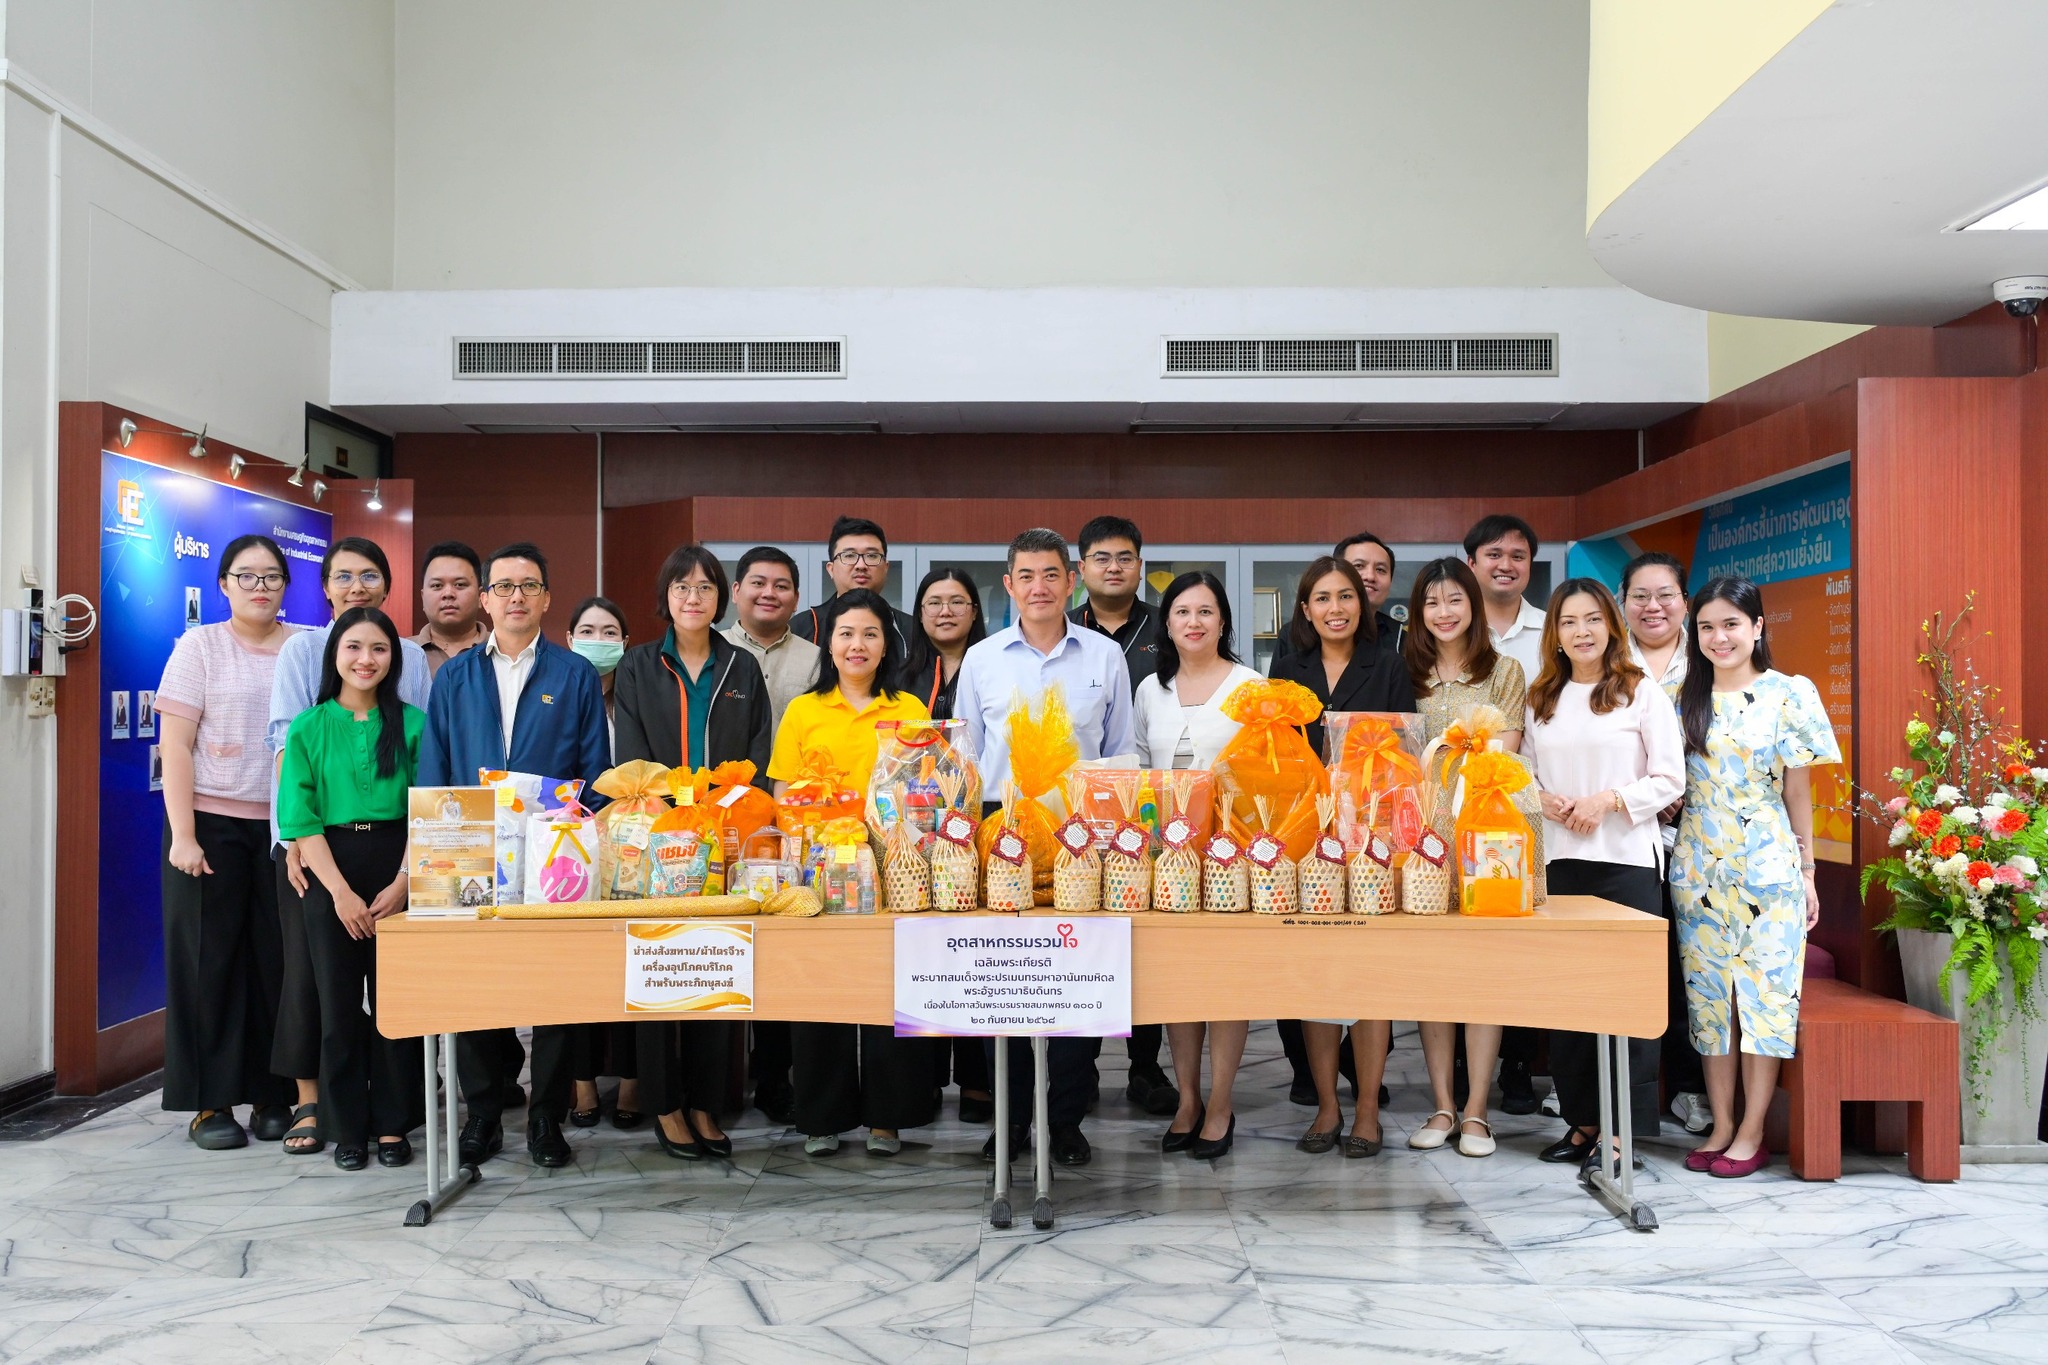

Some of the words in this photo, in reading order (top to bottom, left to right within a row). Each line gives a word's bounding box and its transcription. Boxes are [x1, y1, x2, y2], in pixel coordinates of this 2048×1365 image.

[174, 531, 210, 560] ผู้บริหาร
[946, 923, 1078, 952] อุตสาหกรรมรวมใจ
[642, 960, 733, 975] เครื่องอุปโภคบริโภค
[974, 956, 1052, 968] เฉลิมพระเกียรติ
[911, 970, 1115, 982] พระบาทสมเด็จพระปรเมนทรมหาอานันทมหิดล
[644, 977, 734, 990] สำหรับพระภิกษุสงฆ์
[963, 986, 1062, 998] พระอัฐมรามาธิบดินทร
[924, 1000, 1071, 1010] เนื่องในโอกาสวันพระบรมราชสมภพครบ
[1096, 1000, 1102, 1010] ปี
[970, 1016, 985, 1024] ๒๐
[987, 1015, 1024, 1024] กันยายน
[1026, 1015, 1056, 1024] ๒๕๖๘
